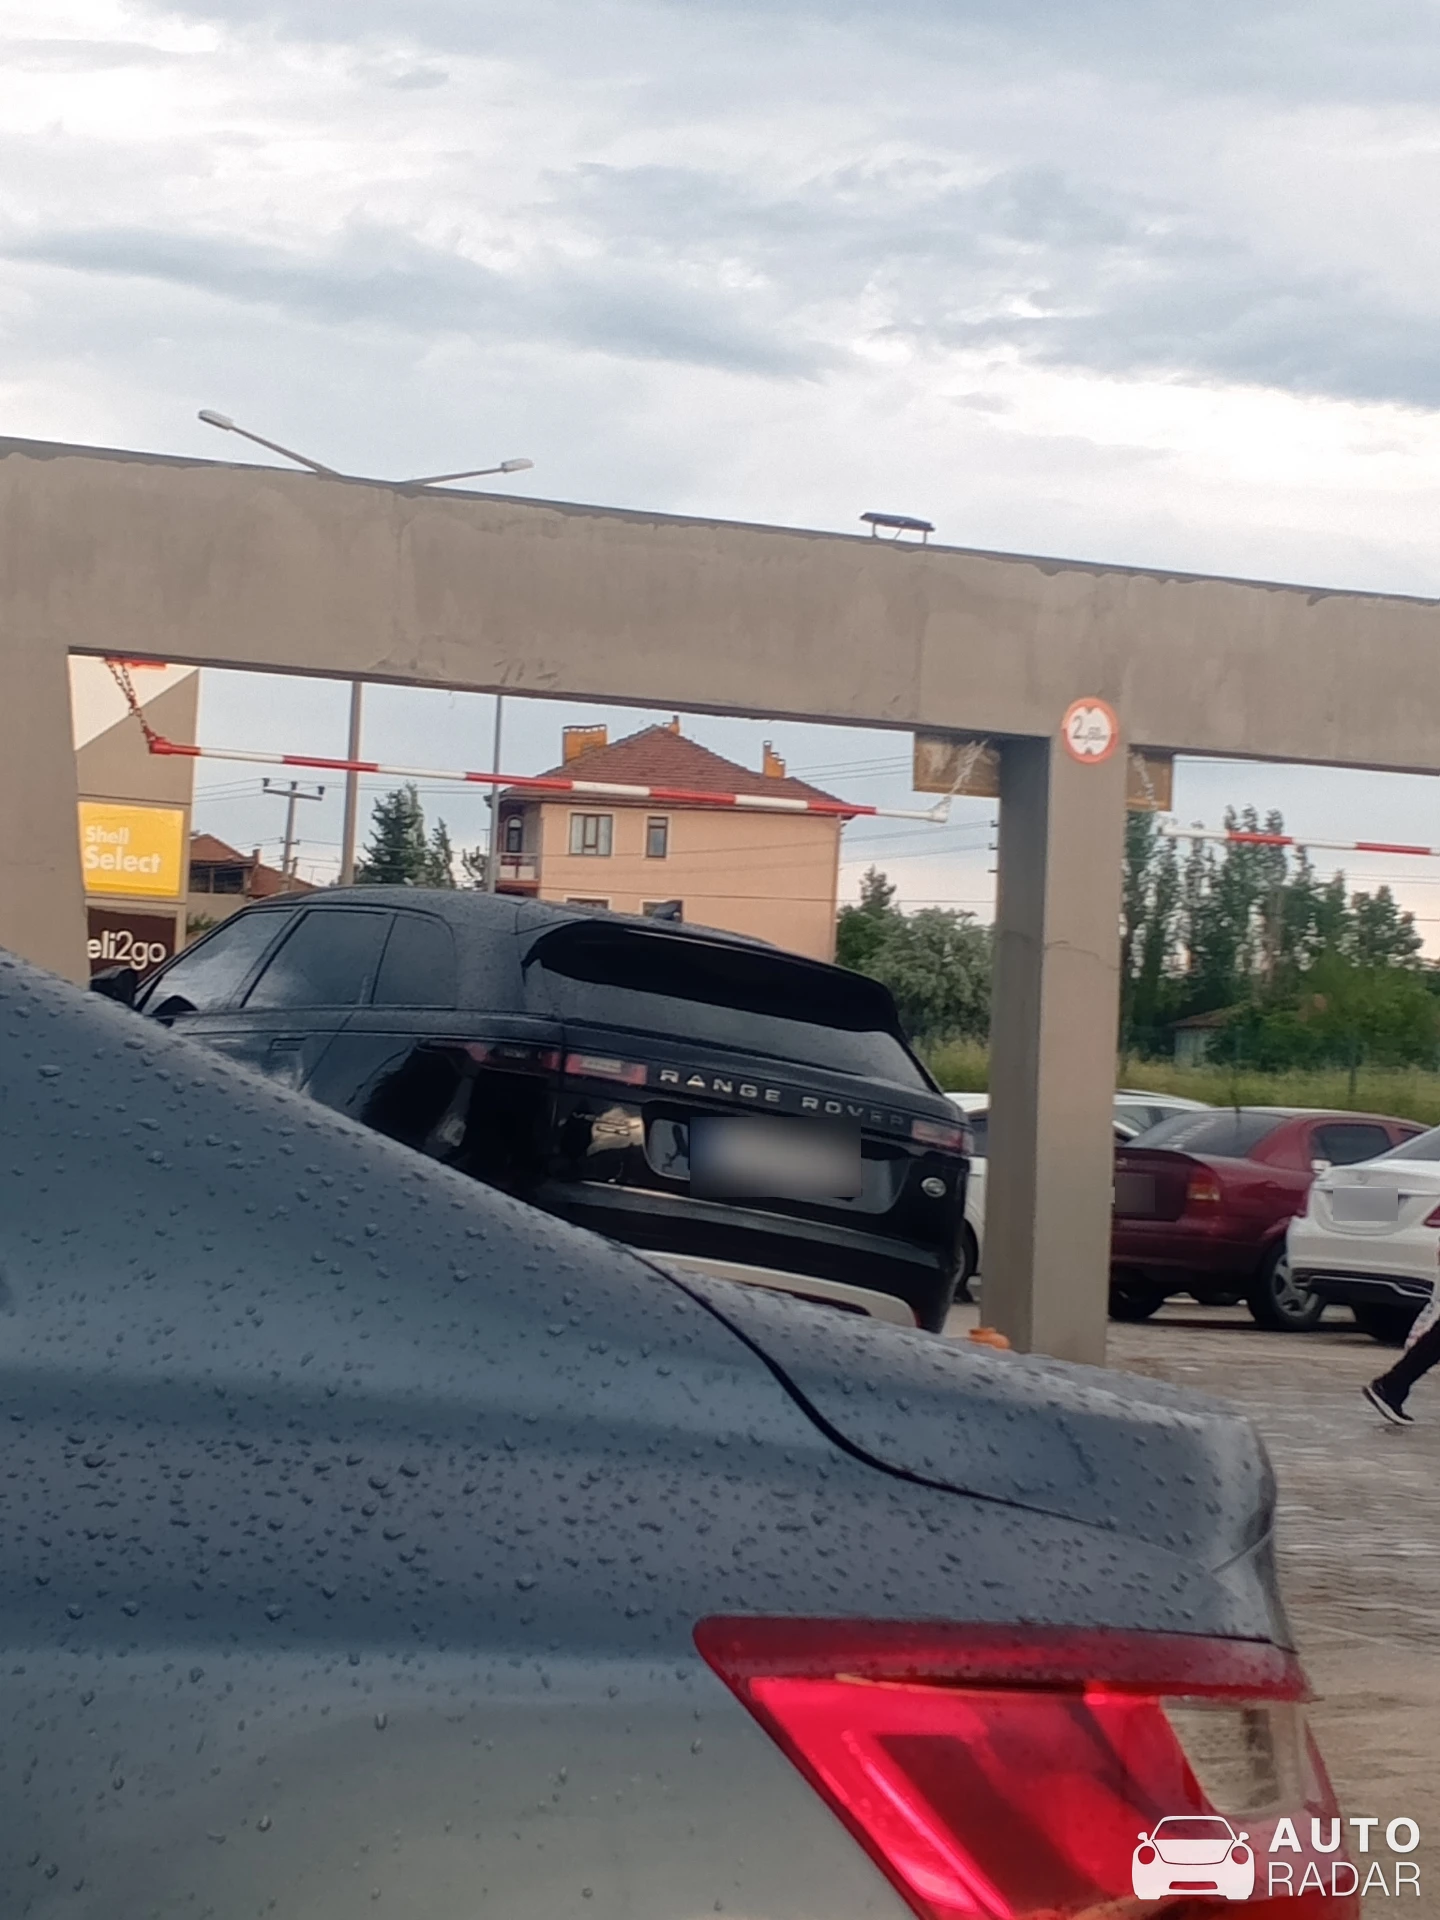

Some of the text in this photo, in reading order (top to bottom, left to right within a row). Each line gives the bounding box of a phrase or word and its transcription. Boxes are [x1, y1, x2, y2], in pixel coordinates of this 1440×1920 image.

[85, 825, 130, 845] Shell
[84, 845, 162, 874] Select
[87, 930, 167, 971] eli2go
[659, 1069, 905, 1127] RANGE ROVER
